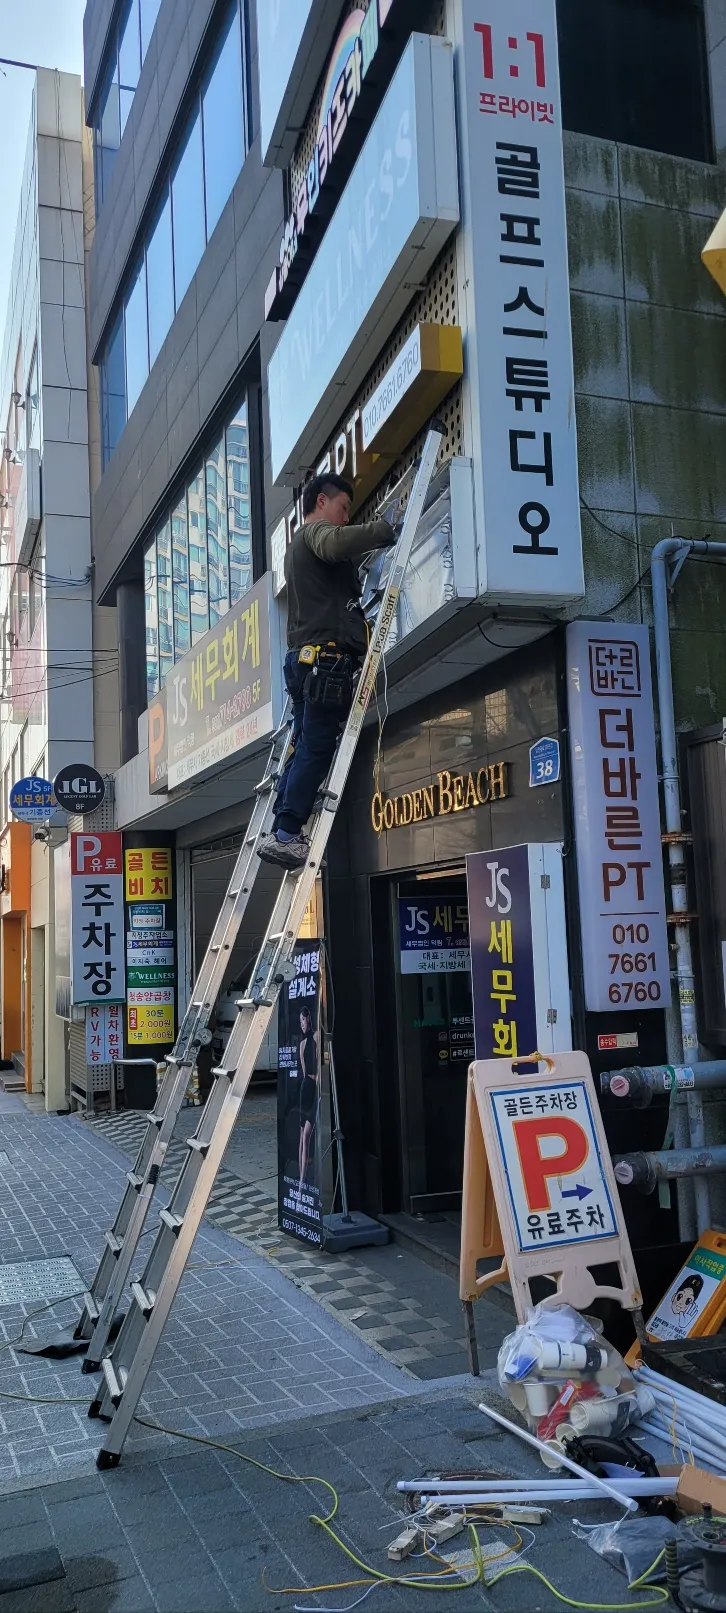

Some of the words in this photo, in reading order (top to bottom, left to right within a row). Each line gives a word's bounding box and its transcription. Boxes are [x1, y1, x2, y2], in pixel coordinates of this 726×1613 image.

[473, 22, 546, 88] 1:1
[479, 92, 555, 125] 프라이빗
[494, 141, 558, 556] 골프스튜디오
[363, 341, 419, 438] 010.7661.6760
[172, 674, 188, 727] JS
[189, 599, 261, 711] 세무회계
[252, 678, 261, 704] 5F
[149, 702, 165, 785] P
[536, 759, 553, 779] 38
[598, 707, 643, 852] 더바른
[13, 793, 57, 806] 세무회계
[25, 779, 42, 793] JS
[371, 784, 435, 832] GOLDEN
[436, 761, 507, 816] BEACH
[76, 835, 102, 872] P
[89, 857, 118, 871] 유료
[127, 852, 169, 871] 골든
[128, 877, 169, 896] 비치
[485, 861, 512, 914] JS
[601, 860, 651, 902] PT
[405, 906, 430, 935] JS
[612, 922, 650, 945] 010
[82, 883, 117, 996] 주차장
[405, 939, 430, 947] 세무법인
[290, 950, 320, 975] 성체형
[422, 951, 444, 960] 대표:
[608, 951, 657, 976] 7661
[135, 971, 175, 980] WELLNESS
[288, 975, 316, 1000] 설계소
[129, 991, 171, 1002] 청송양곱창
[488, 919, 518, 1064] 세무회
[608, 980, 661, 1004] 6760
[108, 1005, 119, 1060] 월차환영
[503, 1090, 578, 1118] 골든주차장
[511, 1115, 590, 1213] P
[526, 1204, 605, 1240] 유료주차
